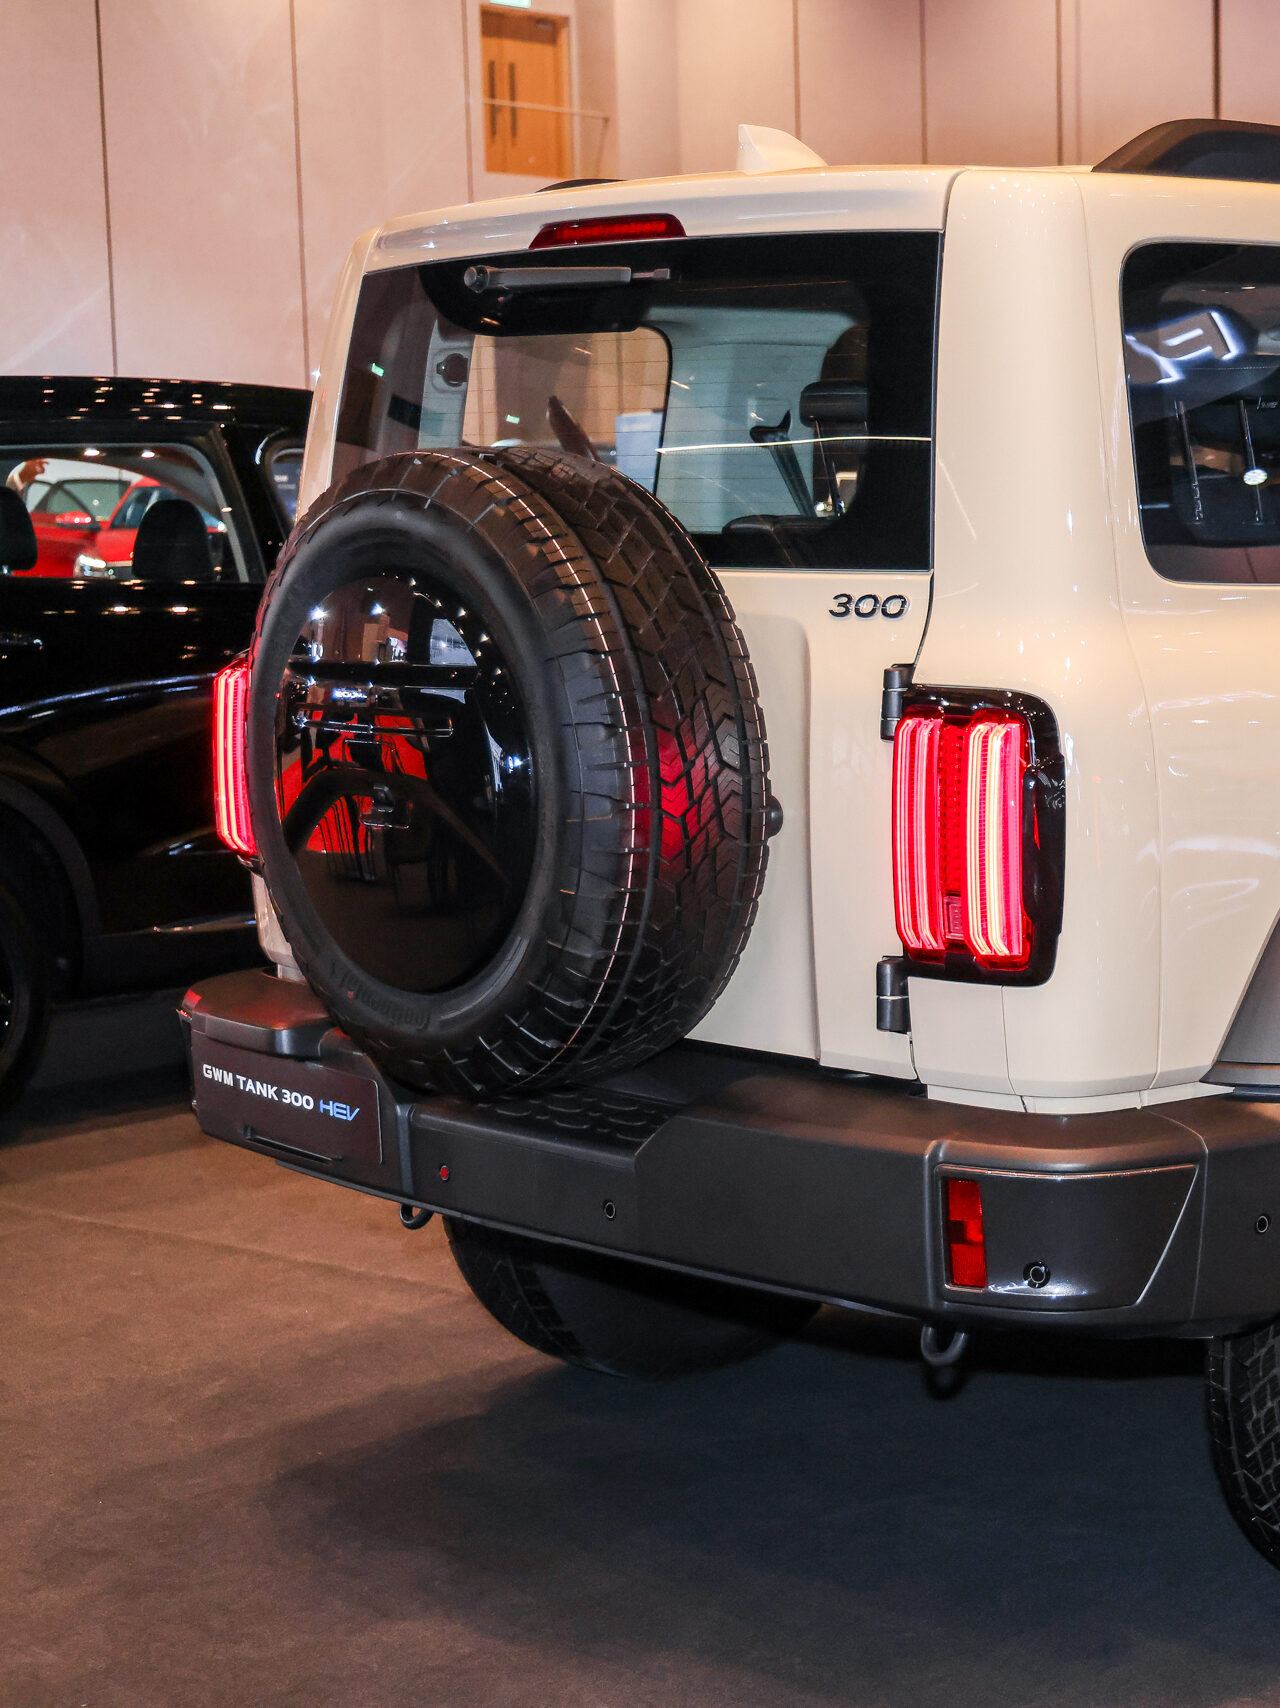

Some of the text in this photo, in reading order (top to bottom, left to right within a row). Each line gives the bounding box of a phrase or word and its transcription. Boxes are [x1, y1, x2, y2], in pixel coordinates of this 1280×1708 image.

[828, 593, 908, 619] 300
[202, 1063, 361, 1121] GWM TANK 300 HEV
